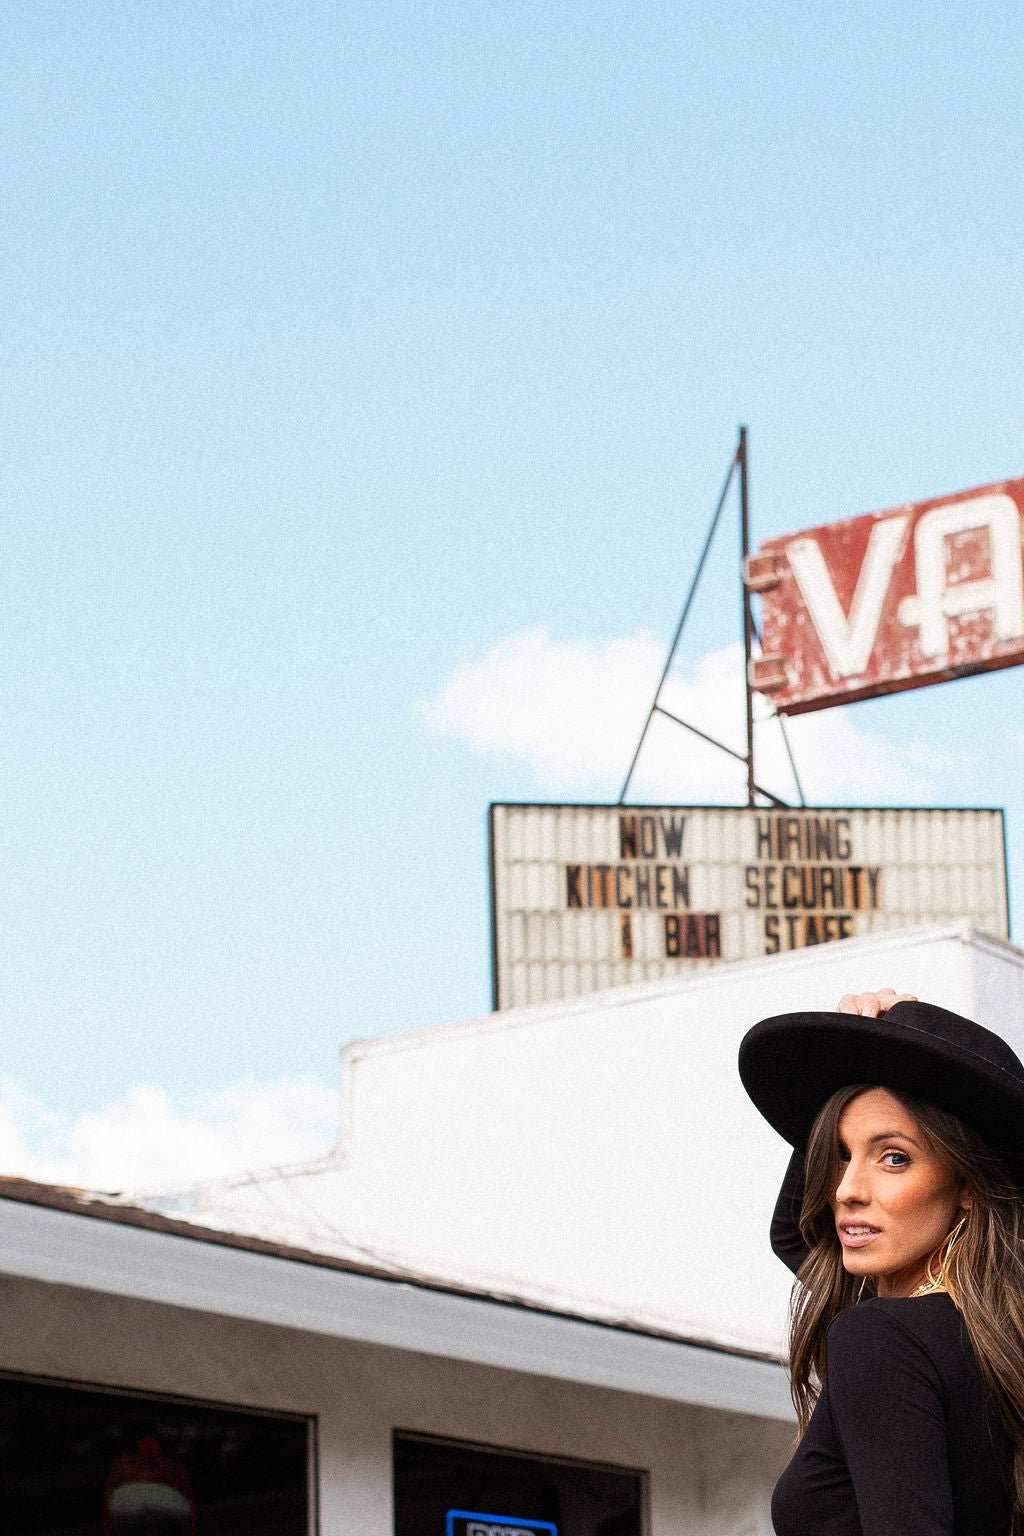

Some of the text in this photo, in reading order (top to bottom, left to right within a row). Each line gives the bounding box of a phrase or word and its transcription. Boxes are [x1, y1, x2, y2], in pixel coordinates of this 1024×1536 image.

[619, 816, 851, 860] NOW HIRING
[566, 865, 882, 910] KITCHEN SECURITY
[665, 914, 721, 958] BAR
